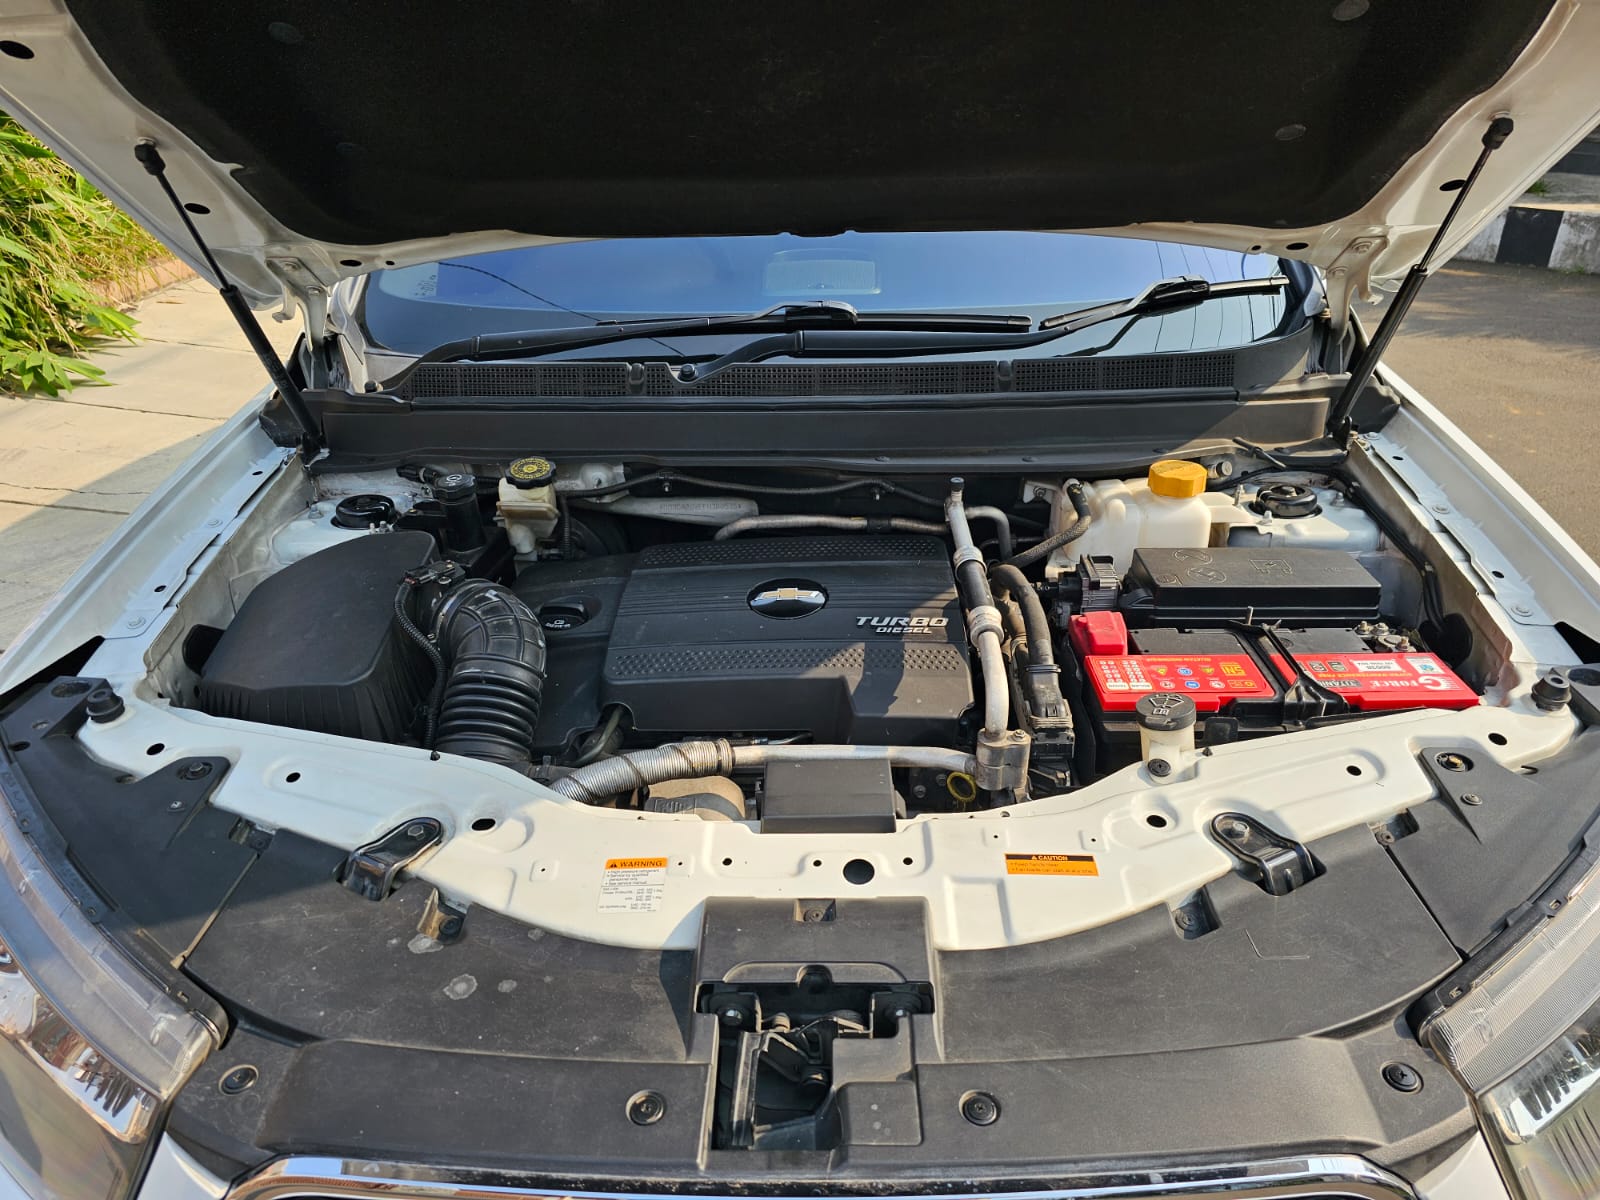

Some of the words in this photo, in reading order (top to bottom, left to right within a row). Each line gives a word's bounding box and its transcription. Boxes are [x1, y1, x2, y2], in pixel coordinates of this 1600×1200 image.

[856, 616, 949, 626] TURBO
[1220, 662, 1246, 676] SNI
[1370, 680, 1419, 689] FORCE
